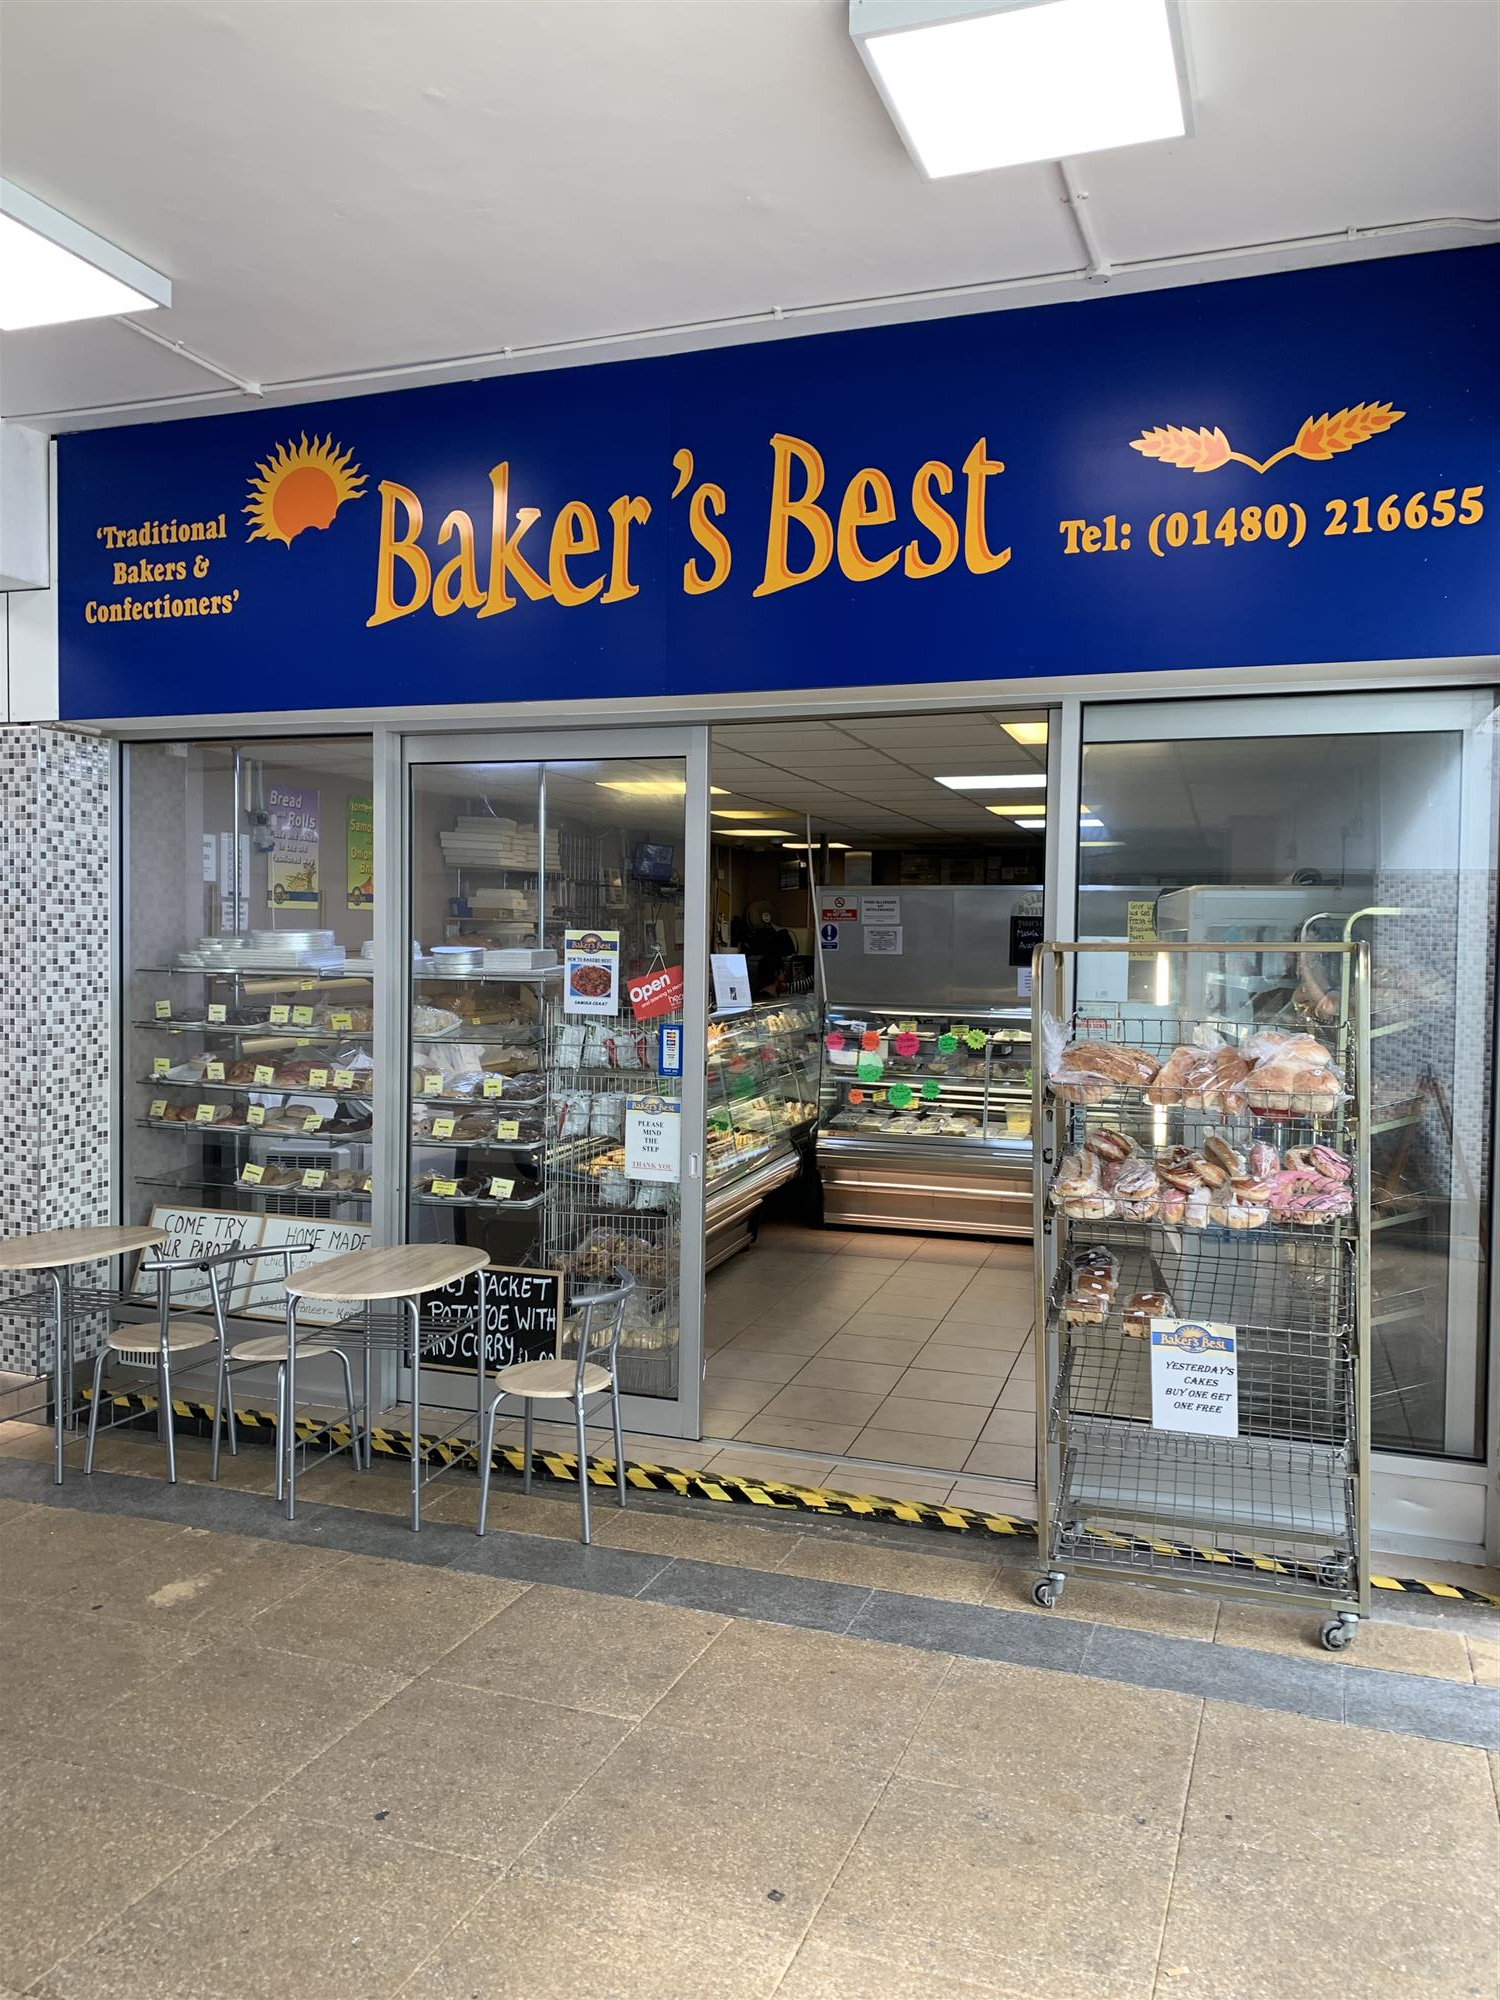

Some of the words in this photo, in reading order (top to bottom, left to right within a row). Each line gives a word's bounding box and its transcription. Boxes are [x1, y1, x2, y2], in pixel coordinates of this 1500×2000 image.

[366, 449, 731, 627] Baker's
[753, 433, 1011, 597] Best
[1060, 515, 1131, 554] Tel:
[1149, 503, 1306, 557] (01480)
[1324, 486, 1483, 535] 216655
[113, 559, 186, 584] Bakers
[194, 555, 209, 578] &
[270, 790, 302, 809] Bread
[288, 811, 316, 829] Rolls
[630, 974, 671, 1003] Open
[632, 1102, 658, 1111] Baker's
[659, 1104, 675, 1112] Best
[638, 1120, 664, 1128] PLEASE
[632, 1161, 656, 1169] THANK
[164, 1214, 207, 1236] COME
[214, 1216, 248, 1239] TRY
[285, 1227, 325, 1248] HOME
[329, 1230, 371, 1250] MADE
[514, 1305, 556, 1331] WITH
[1160, 1334, 1199, 1348] Baker's
[1201, 1339, 1225, 1350] Best
[1165, 1360, 1235, 1376] YESTERDAY'S
[1184, 1376, 1219, 1387] CAKES
[1165, 1388, 1188, 1397] BUY
[1188, 1390, 1208, 1399] ONE
[1211, 1392, 1232, 1401] GET
[1174, 1401, 1194, 1411] ONE
[1195, 1403, 1223, 1413] FREE
